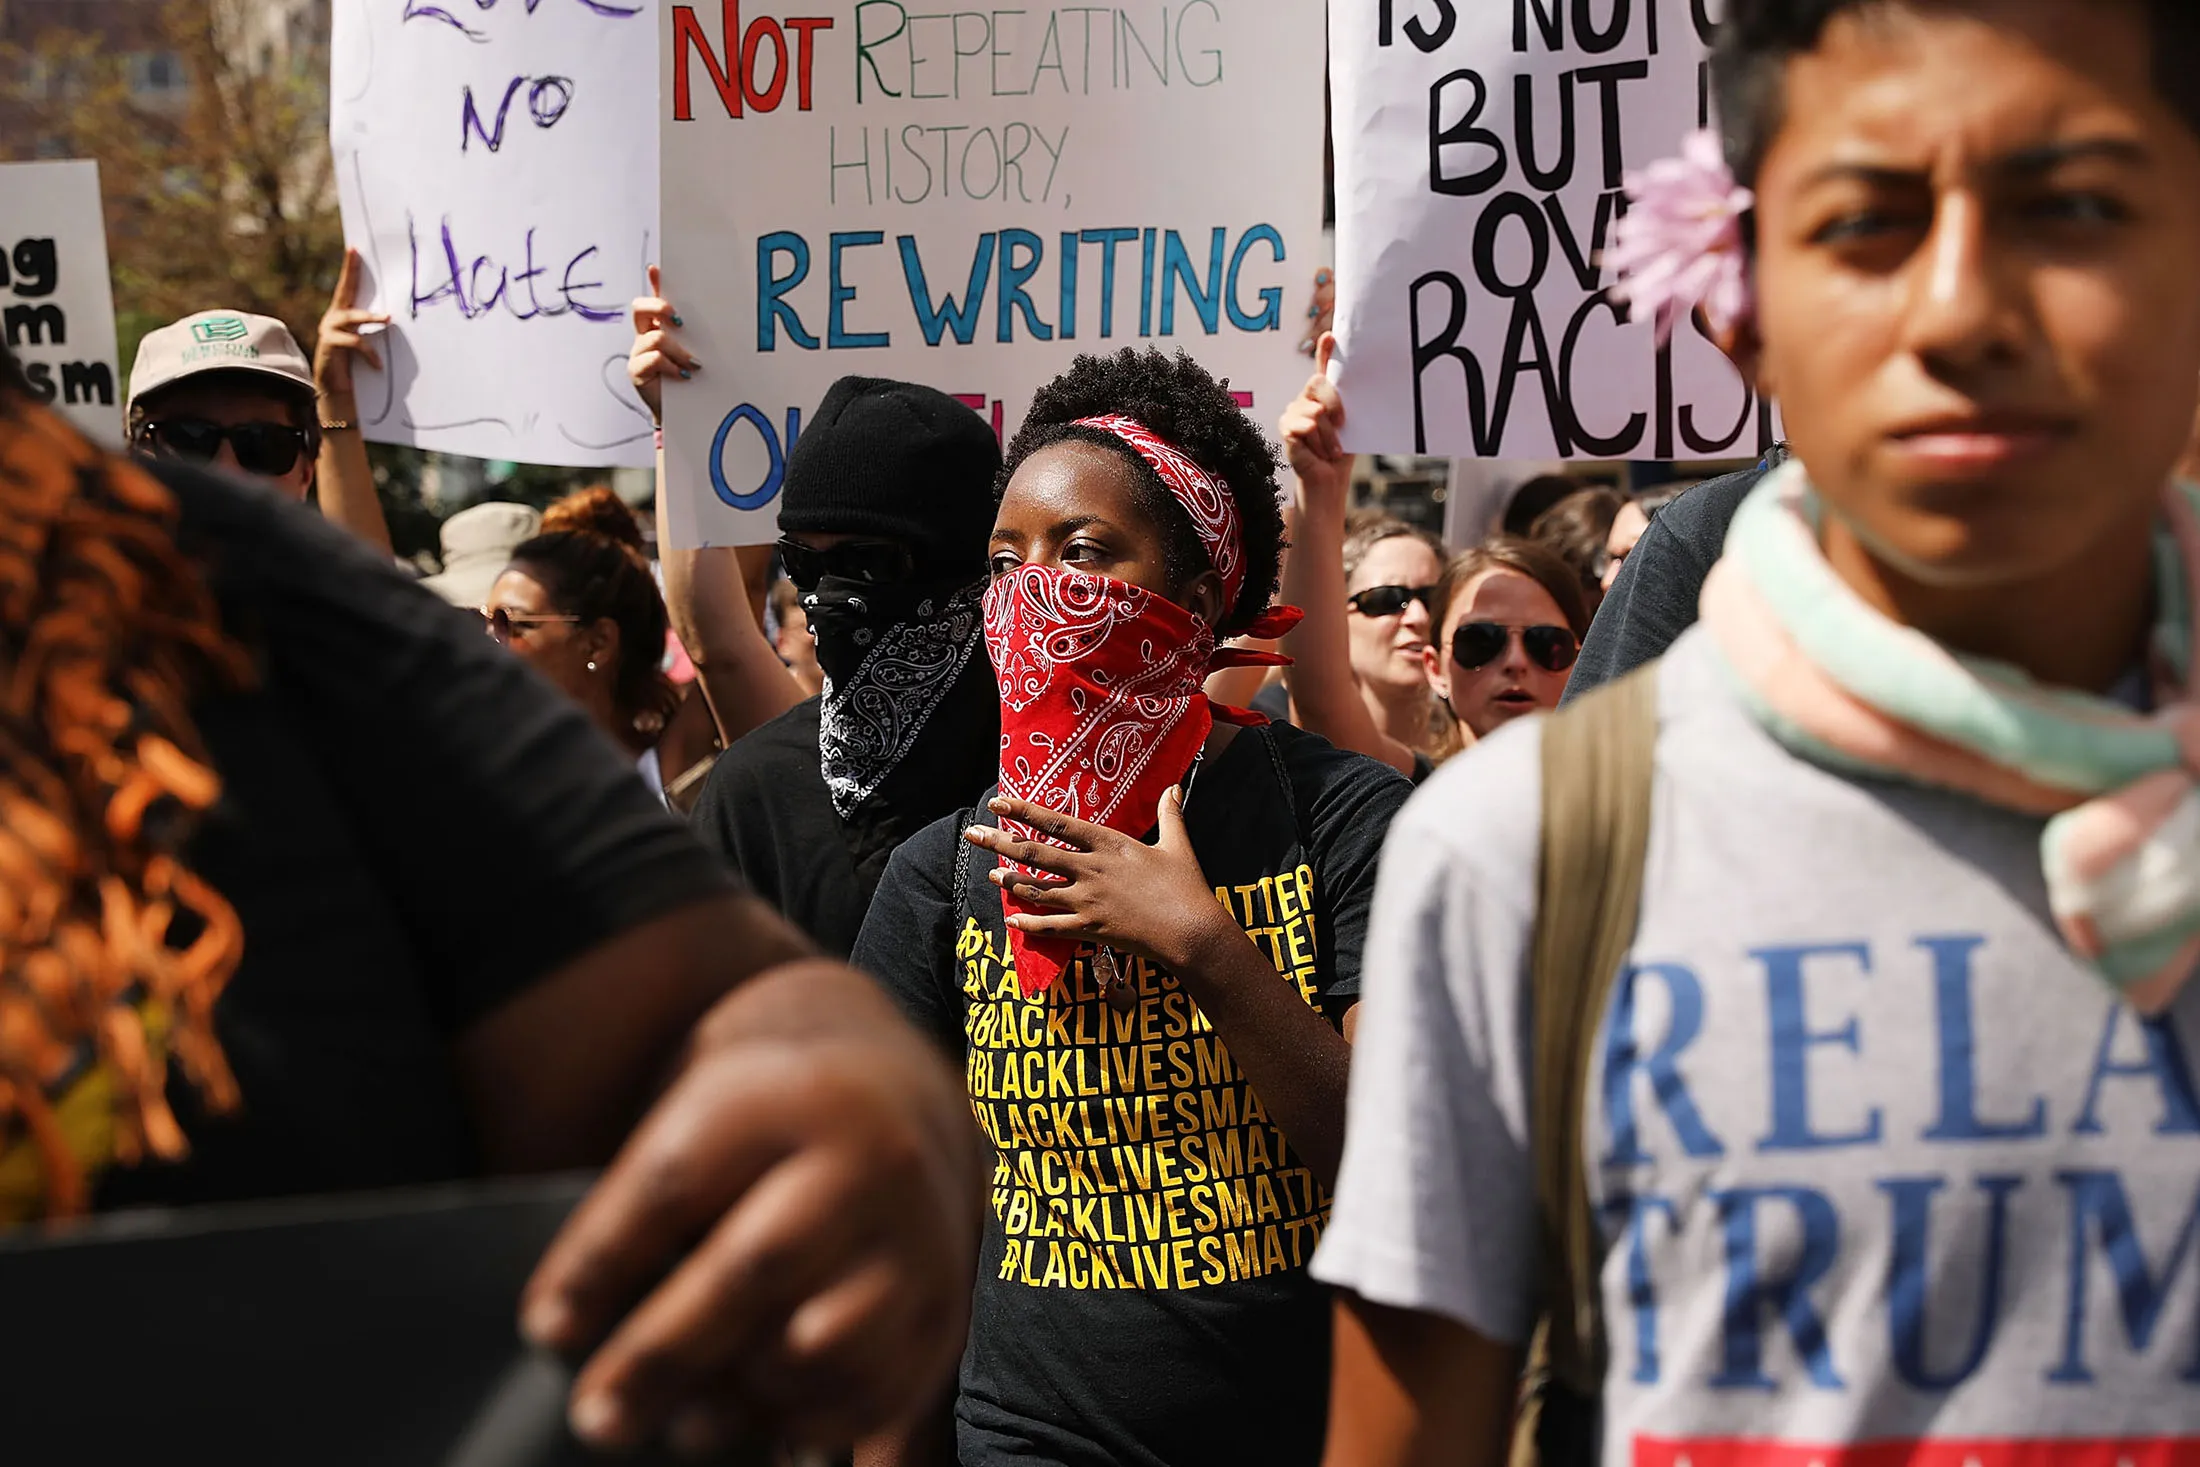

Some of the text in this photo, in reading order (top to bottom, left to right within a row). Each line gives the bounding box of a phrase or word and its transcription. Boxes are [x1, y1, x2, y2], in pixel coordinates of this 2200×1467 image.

[673, 0, 1222, 121] NOT REPEATING
[830, 124, 1072, 209] HISTORY,
[1430, 60, 1648, 196] BUT
[757, 223, 1286, 352] REWRITING
